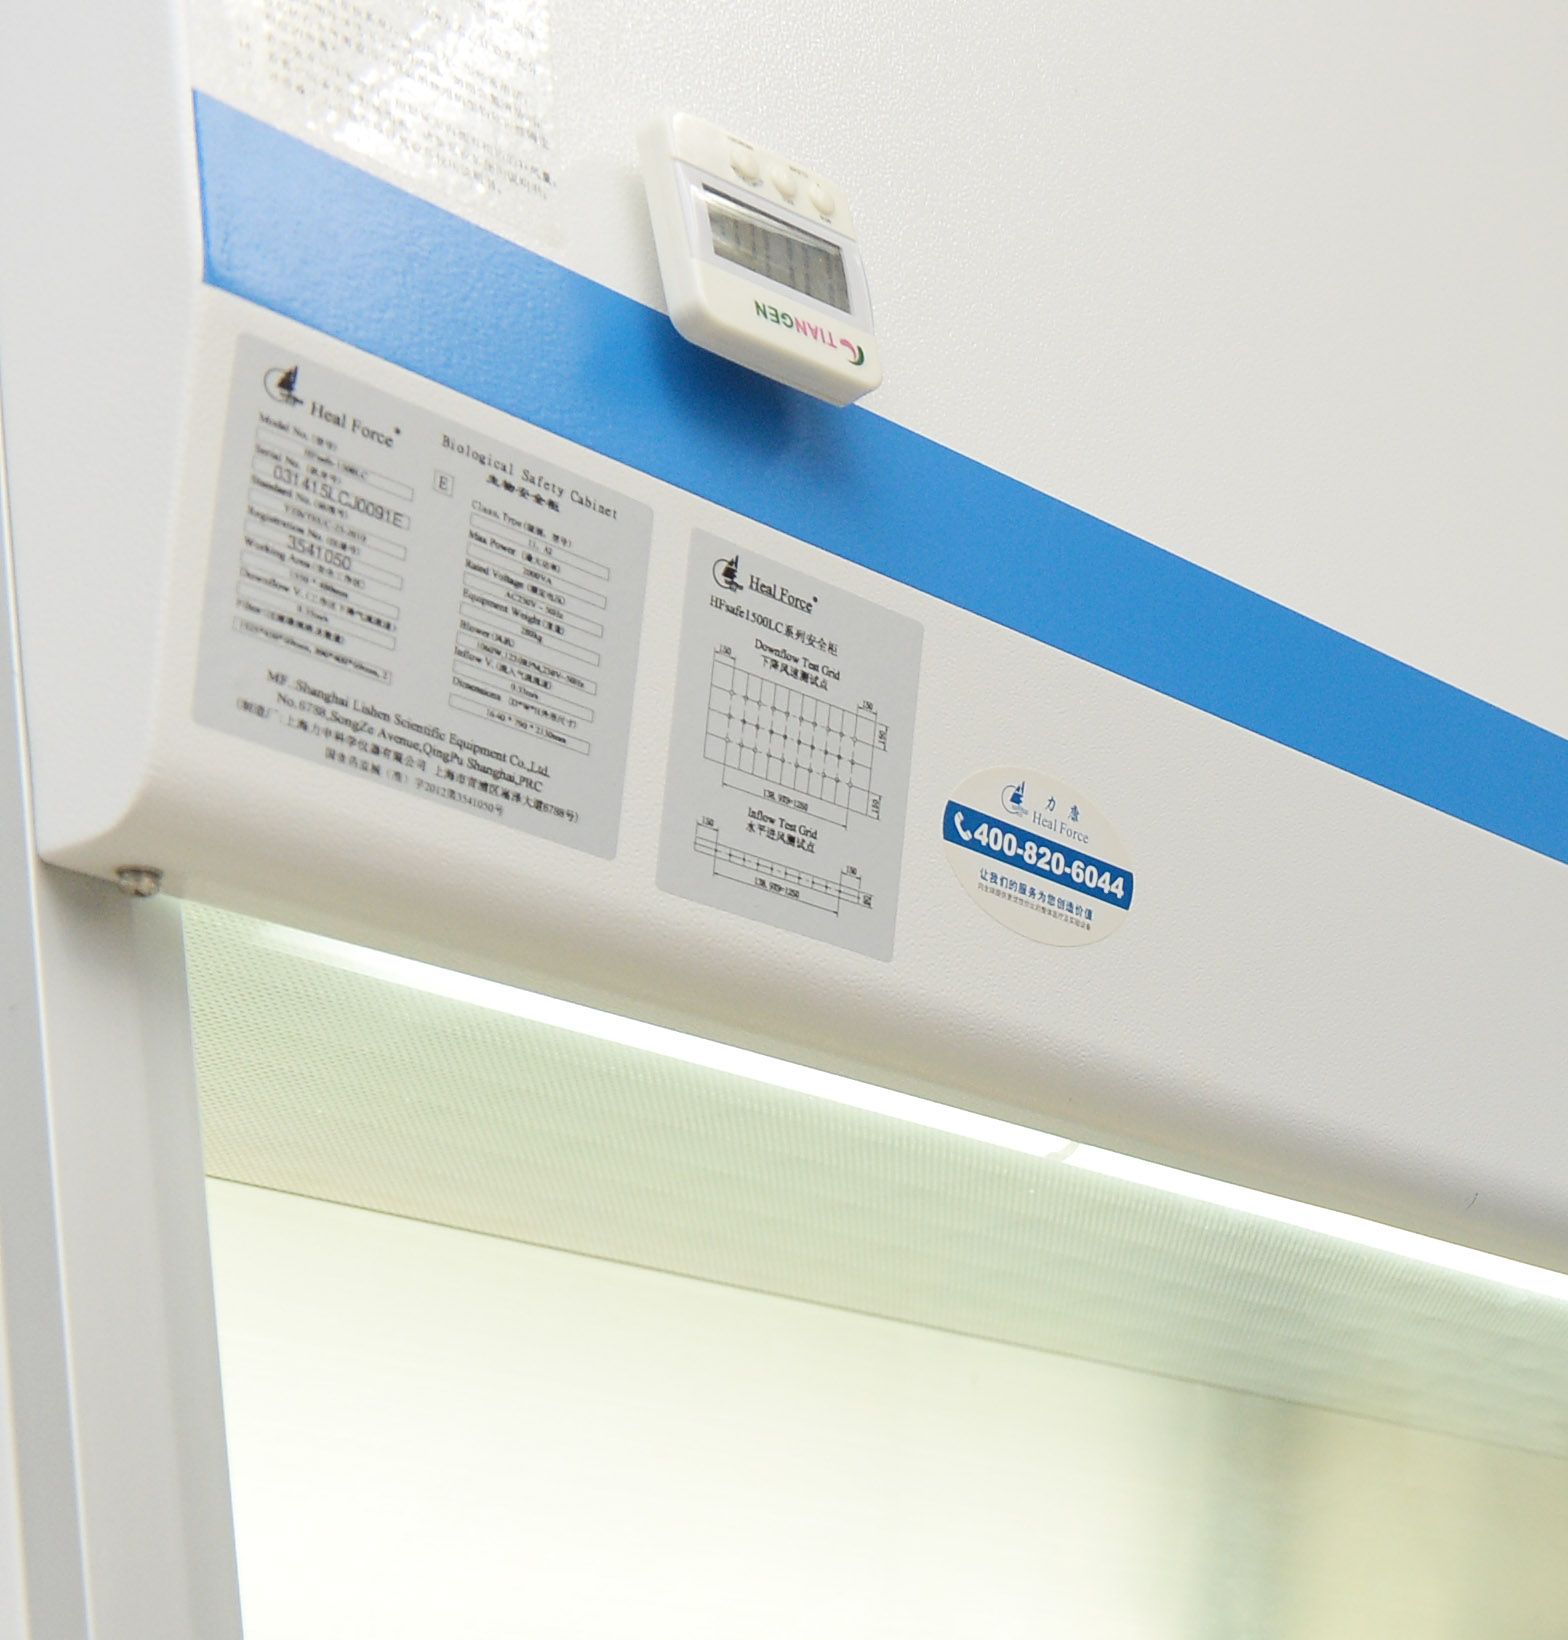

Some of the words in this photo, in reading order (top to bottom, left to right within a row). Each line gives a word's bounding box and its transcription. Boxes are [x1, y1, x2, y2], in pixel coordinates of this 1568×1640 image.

[754, 300, 837, 348] TIANGEN
[310, 401, 347, 429] Heal
[351, 418, 393, 448] Force
[441, 434, 514, 477] Biological
[521, 467, 564, 498] Safety
[569, 487, 617, 519] Cabinet
[748, 574, 776, 598] Heal
[779, 586, 813, 613] Force
[754, 637, 799, 665] Downflow
[802, 656, 820, 673] Test
[820, 663, 840, 681] Grid
[448, 733, 507, 765] Equipment
[748, 805, 776, 826] Inflow
[778, 817, 797, 834] Test
[797, 824, 817, 841] Grid
[1033, 811, 1057, 833] Heal
[1060, 822, 1089, 844] Force
[974, 823, 1125, 899] 400-820-6044
[979, 867, 1093, 921] 让我们的服务为您创造价值
